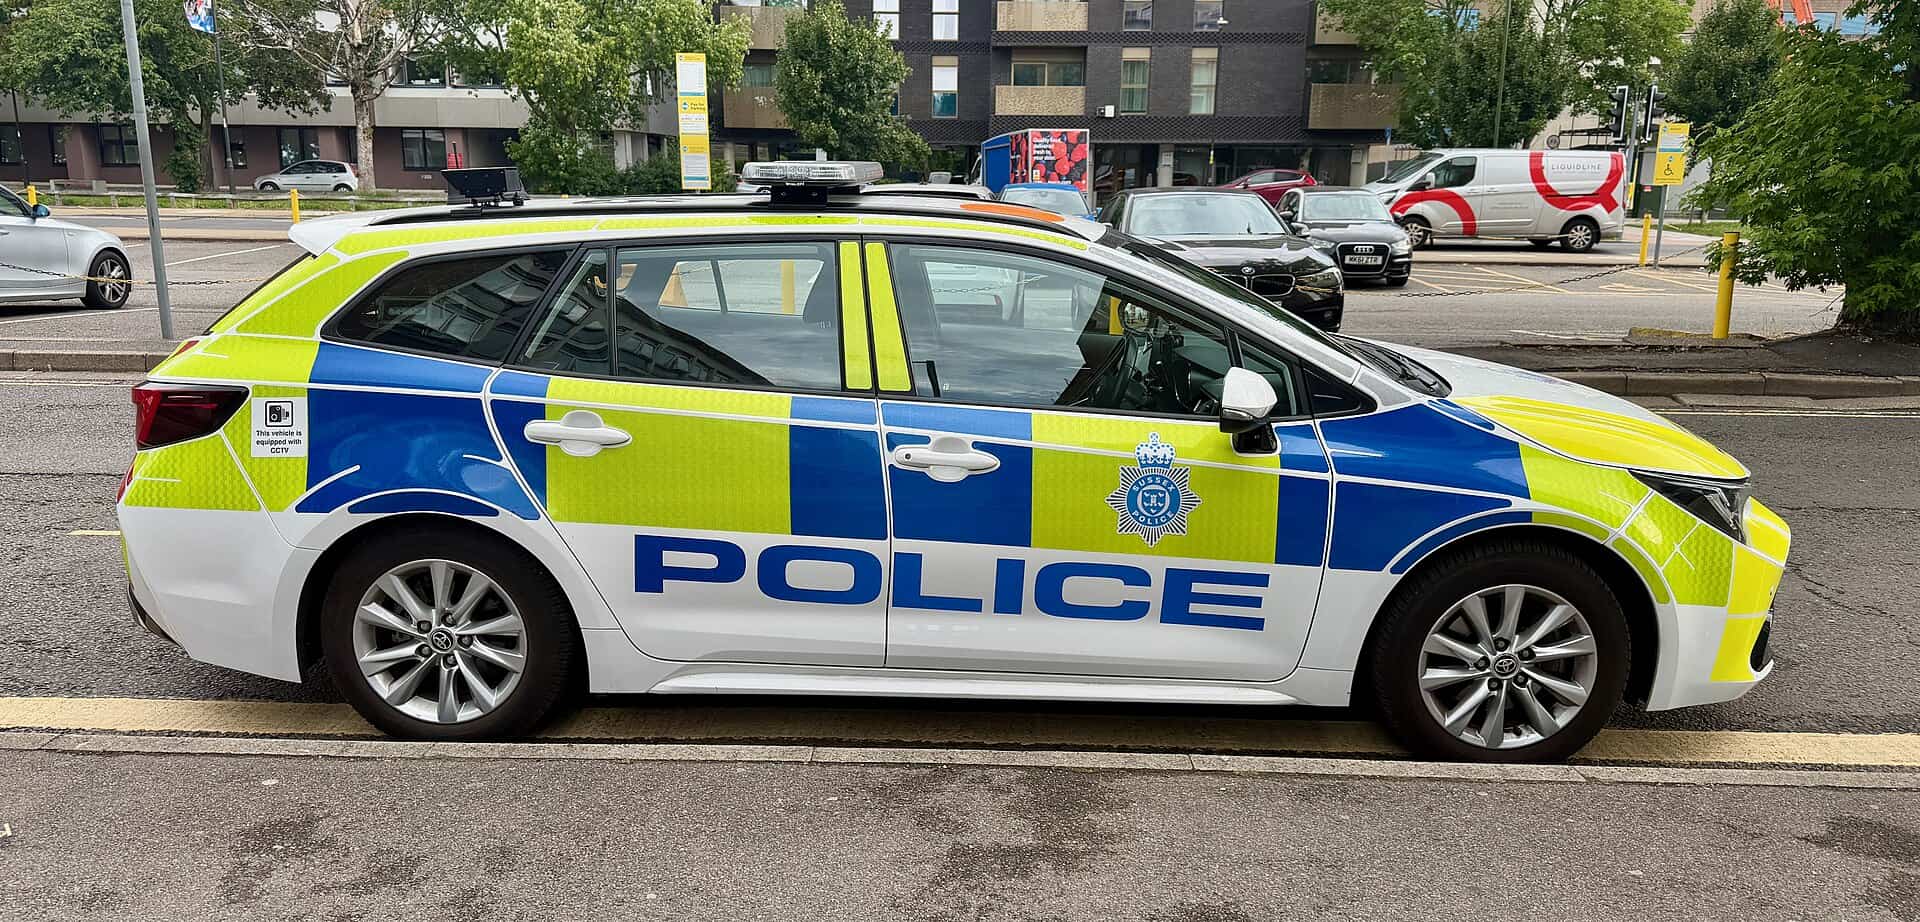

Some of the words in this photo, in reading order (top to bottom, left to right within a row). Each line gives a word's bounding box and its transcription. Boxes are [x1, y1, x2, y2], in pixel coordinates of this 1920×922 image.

[1132, 476, 1176, 492] SUSSEX
[1131, 510, 1174, 525] POLICE
[634, 534, 1270, 631] POLICE
